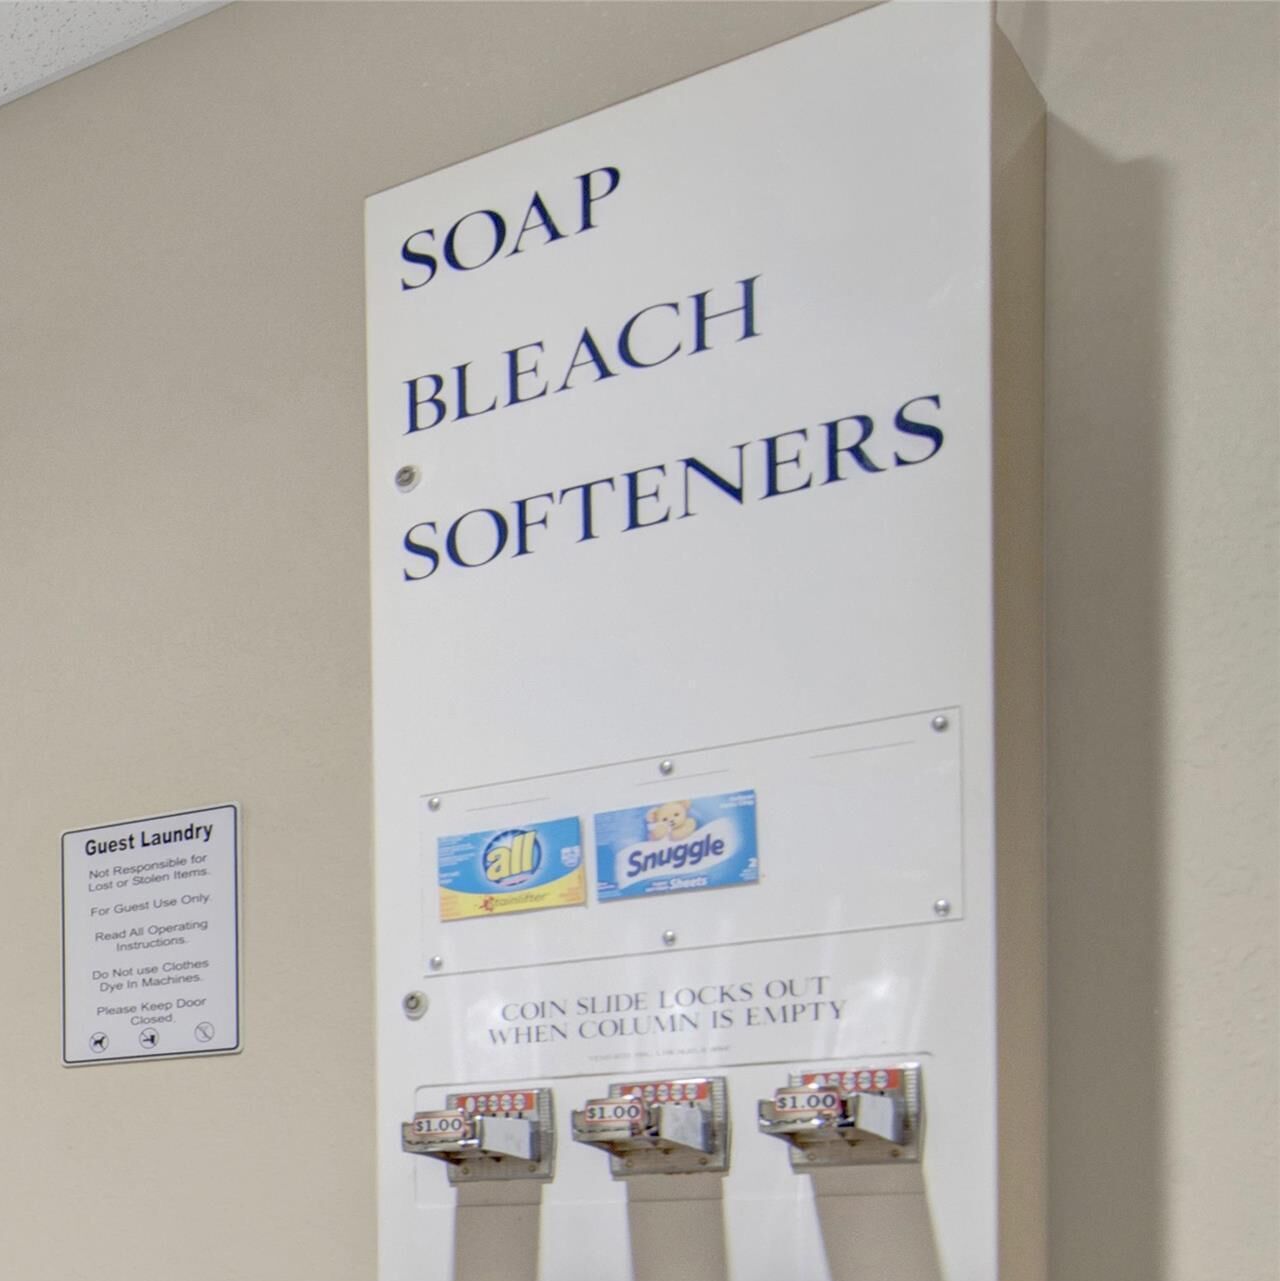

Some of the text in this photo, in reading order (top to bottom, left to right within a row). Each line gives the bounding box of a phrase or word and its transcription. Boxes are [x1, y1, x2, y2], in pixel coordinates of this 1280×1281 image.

[399, 165, 622, 292] SOAP
[401, 273, 764, 436] BLEACH
[402, 393, 945, 583] SOFTENERS
[85, 823, 214, 856] Guest Laundry
[89, 854, 207, 880] Not Responsible for
[486, 831, 537, 881] all
[626, 834, 725, 877] Snuggle
[88, 881, 113, 892] Lost
[117, 879, 128, 888] or
[132, 873, 170, 886] Stolen
[90, 906, 111, 917] For
[113, 901, 150, 915] Guest
[153, 897, 177, 909] Use
[95, 919, 208, 942] Read All Operating
[92, 958, 209, 980] Do Not use Clothes
[100, 982, 123, 994] Dye
[501, 975, 830, 1022] COIN SLIDE LOCKS OUT
[97, 998, 207, 1016] Please Keep Door
[489, 999, 848, 1045] WHEN COLUMN IS EMPTY
[586, 1105, 639, 1120] $1.00
[778, 1094, 836, 1110] $1.00
[415, 1118, 463, 1133] $1.00
